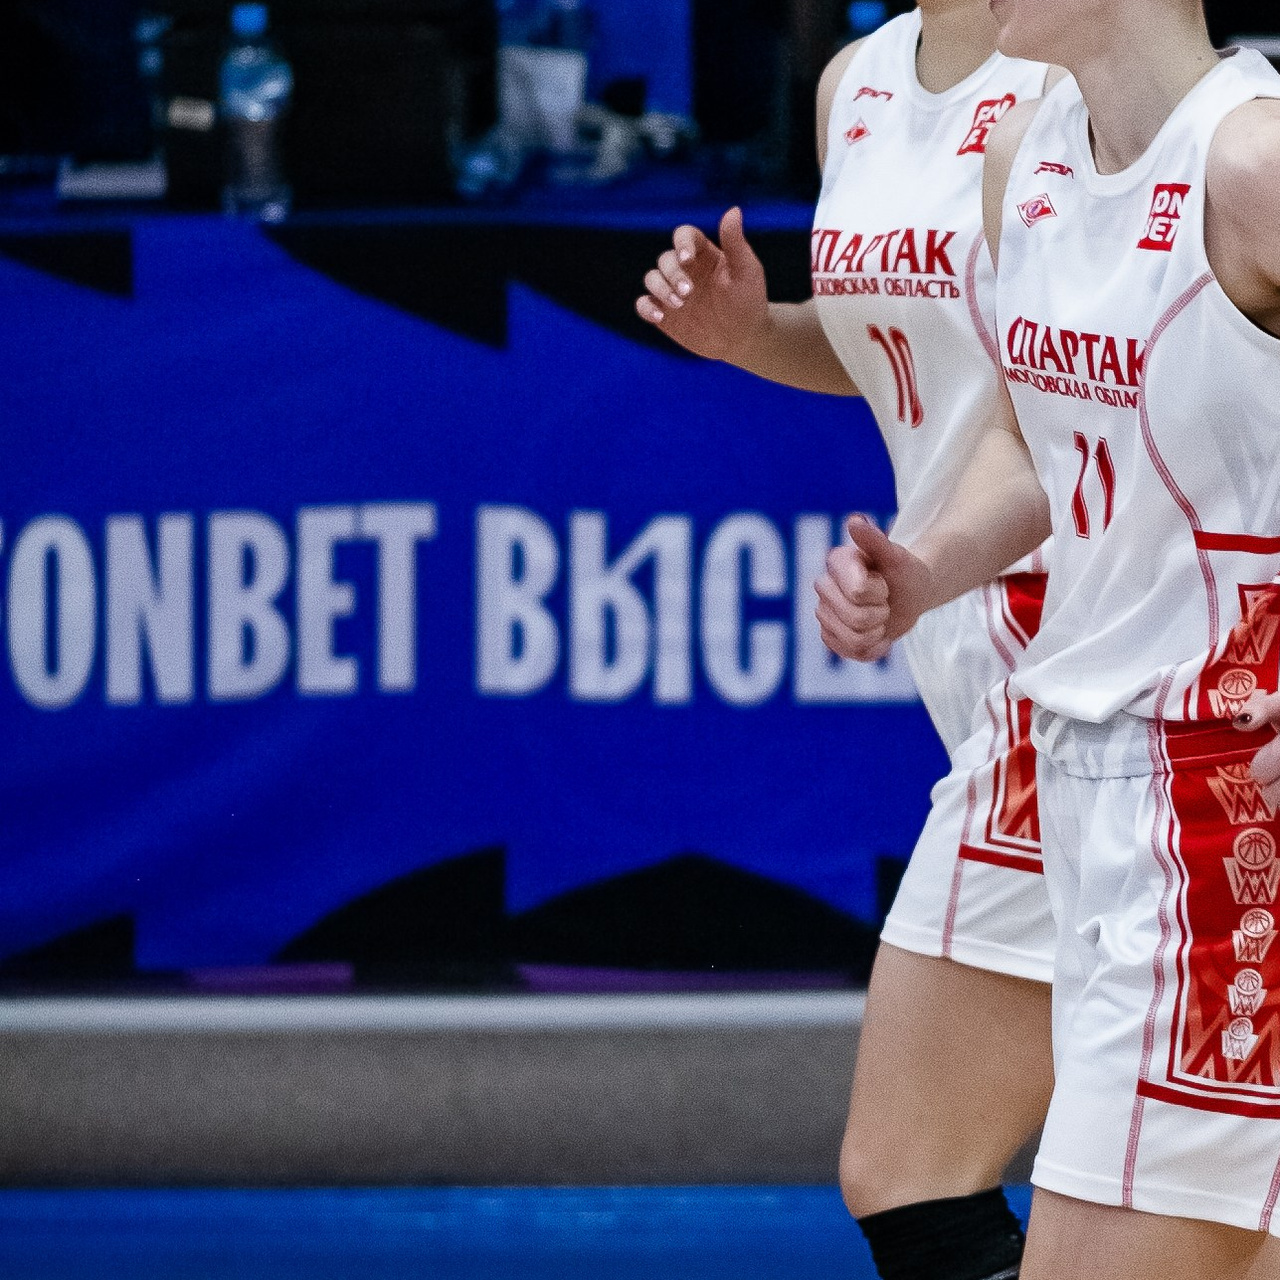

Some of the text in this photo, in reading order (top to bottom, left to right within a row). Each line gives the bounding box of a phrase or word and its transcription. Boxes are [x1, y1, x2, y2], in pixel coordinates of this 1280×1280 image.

[884, 277, 960, 298] ОБЛАСТЬ
[1007, 316, 1147, 387] СПАРТАК
[0, 500, 438, 711] ONBET
